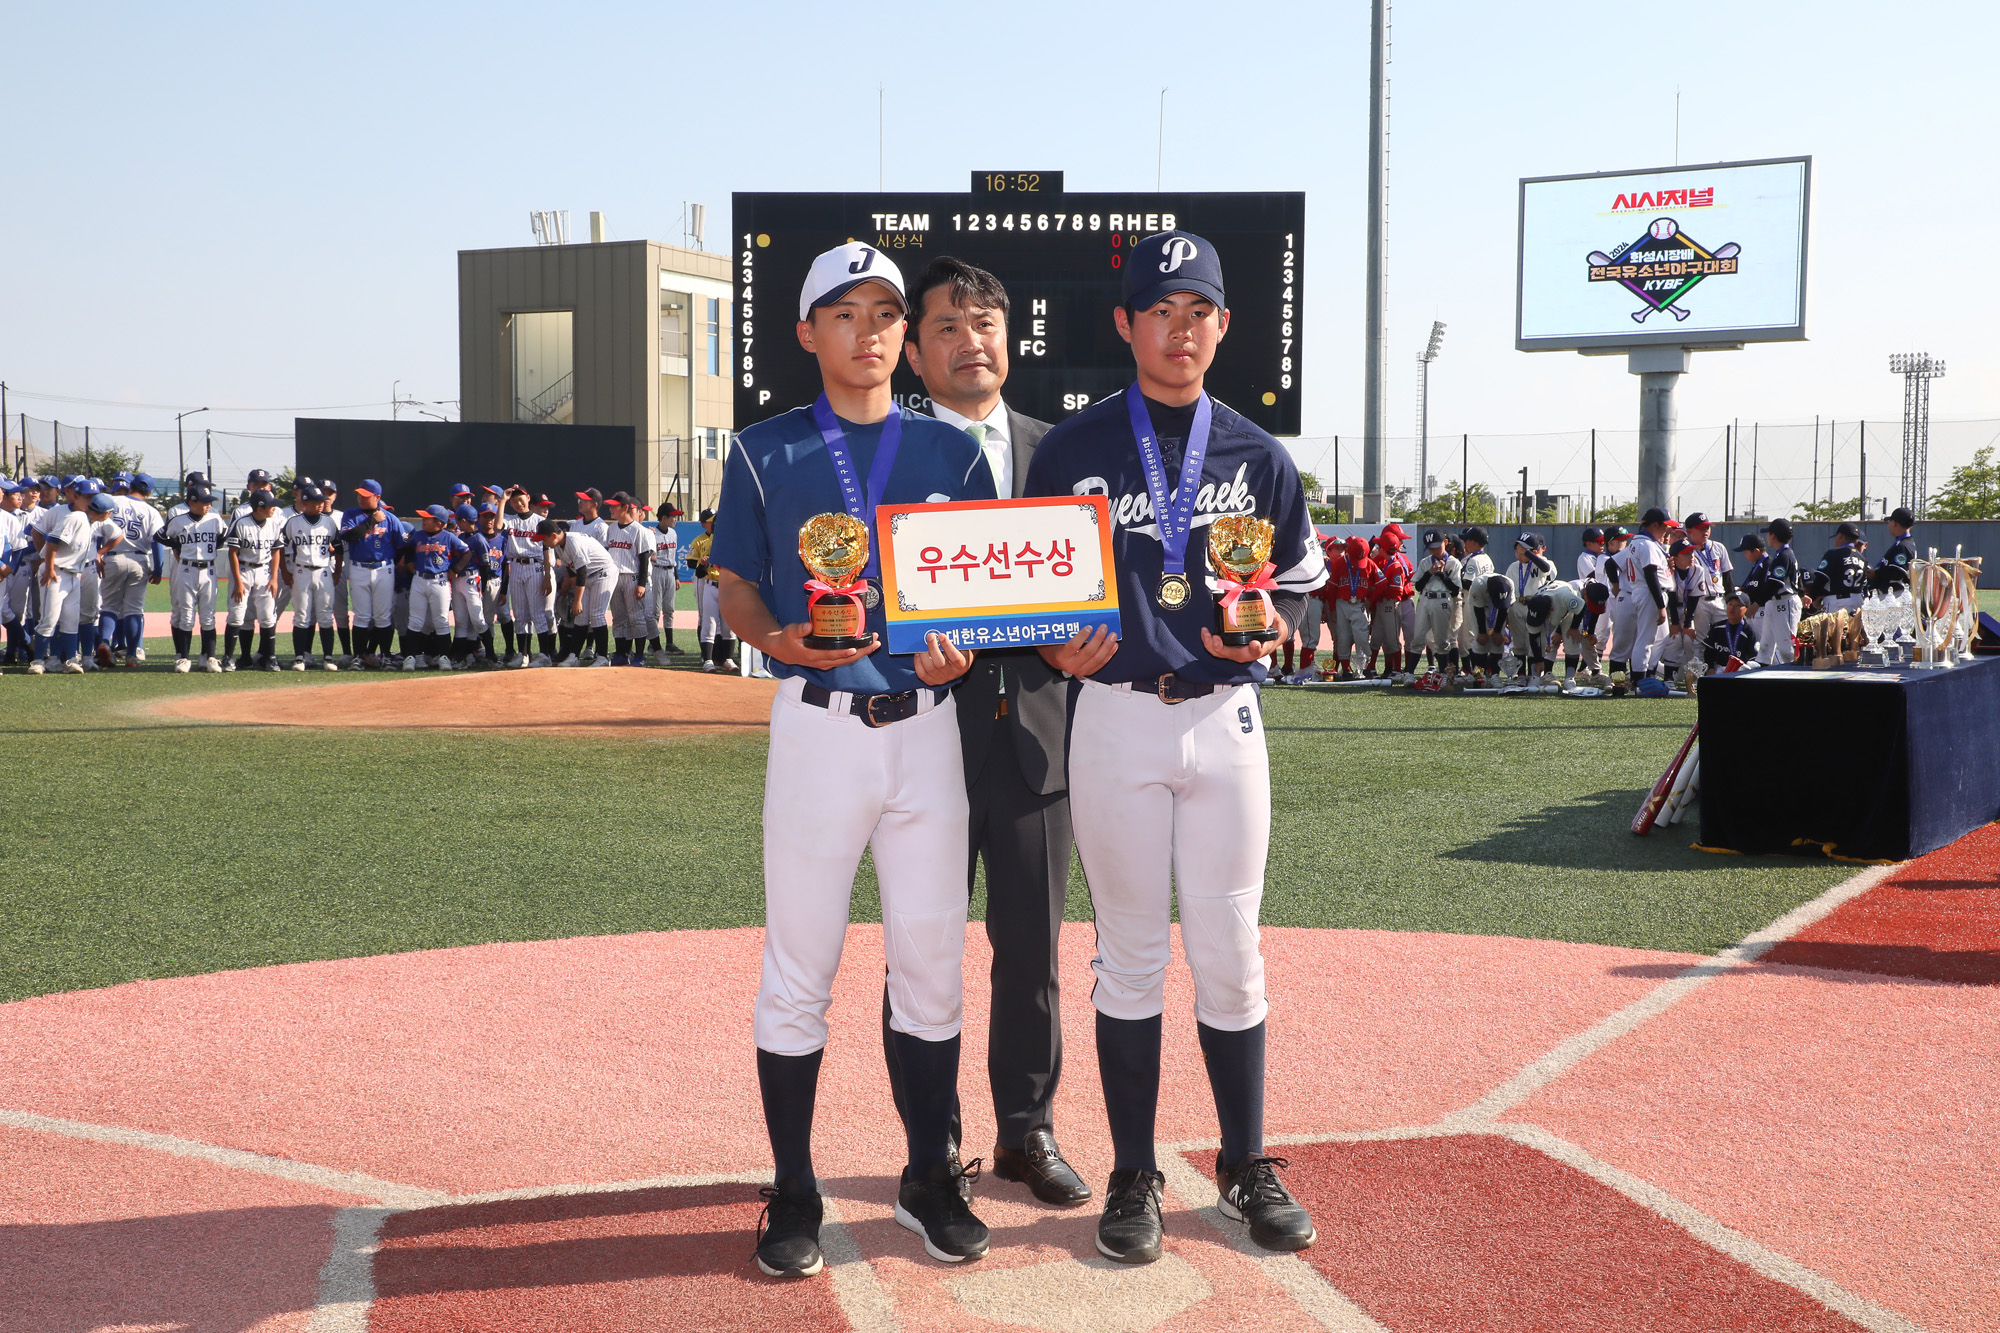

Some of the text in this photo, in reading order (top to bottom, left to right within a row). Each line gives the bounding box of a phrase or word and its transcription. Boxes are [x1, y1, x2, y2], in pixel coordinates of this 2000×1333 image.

[985, 174, 1040, 192] 16:52
[1611, 187, 1714, 209] 시사저널
[872, 213, 930, 231] TEAM
[952, 214, 961, 231] 1
[968, 214, 979, 231] 2
[985, 214, 997, 231] 3
[1002, 214, 1014, 231] 4
[1020, 214, 1031, 231] 5
[1037, 214, 1049, 231] 6
[1054, 214, 1066, 231] 7
[1072, 214, 1083, 231] 8
[1089, 214, 1101, 231] 9
[743, 234, 753, 248] 1
[876, 234, 923, 248] 시상식
[1111, 234, 1121, 248] 0
[1285, 233, 1293, 248] 1
[1158, 236, 1197, 273] P
[1609, 241, 1629, 258] 2024
[1630, 249, 1695, 263] 화성시장배
[743, 252, 753, 266] 2
[849, 247, 876, 274] J
[1111, 255, 1121, 268] 0
[1283, 251, 1294, 266] 2
[743, 269, 753, 283] 3
[1283, 269, 1293, 284] 3
[1590, 259, 1736, 279] 전국유소년야구대회
[1643, 279, 1684, 290] KYBF
[743, 286, 753, 300] 4
[1282, 286, 1293, 301] 4
[743, 304, 753, 318] 5
[1032, 299, 1046, 315] H
[1282, 304, 1293, 319] 5
[743, 321, 753, 336] 6
[1033, 320, 1046, 336] E
[1282, 322, 1292, 337] 6
[743, 338, 753, 353] 7
[1020, 340, 1046, 356] FC
[1282, 339, 1292, 354] 7
[743, 356, 753, 371] 8
[1281, 357, 1292, 372] 8
[743, 373, 753, 388] 9
[1281, 374, 1291, 389] 9
[759, 391, 771, 405] P
[1063, 394, 1089, 410] SP
[207, 544, 213, 553] 8
[320, 546, 326, 555] 3
[917, 539, 1075, 583] 우수선수상
[1843, 569, 1863, 587] 32
[946, 622, 1080, 645] 대한유소년야구연맹
[1237, 706, 1253, 734] 9
